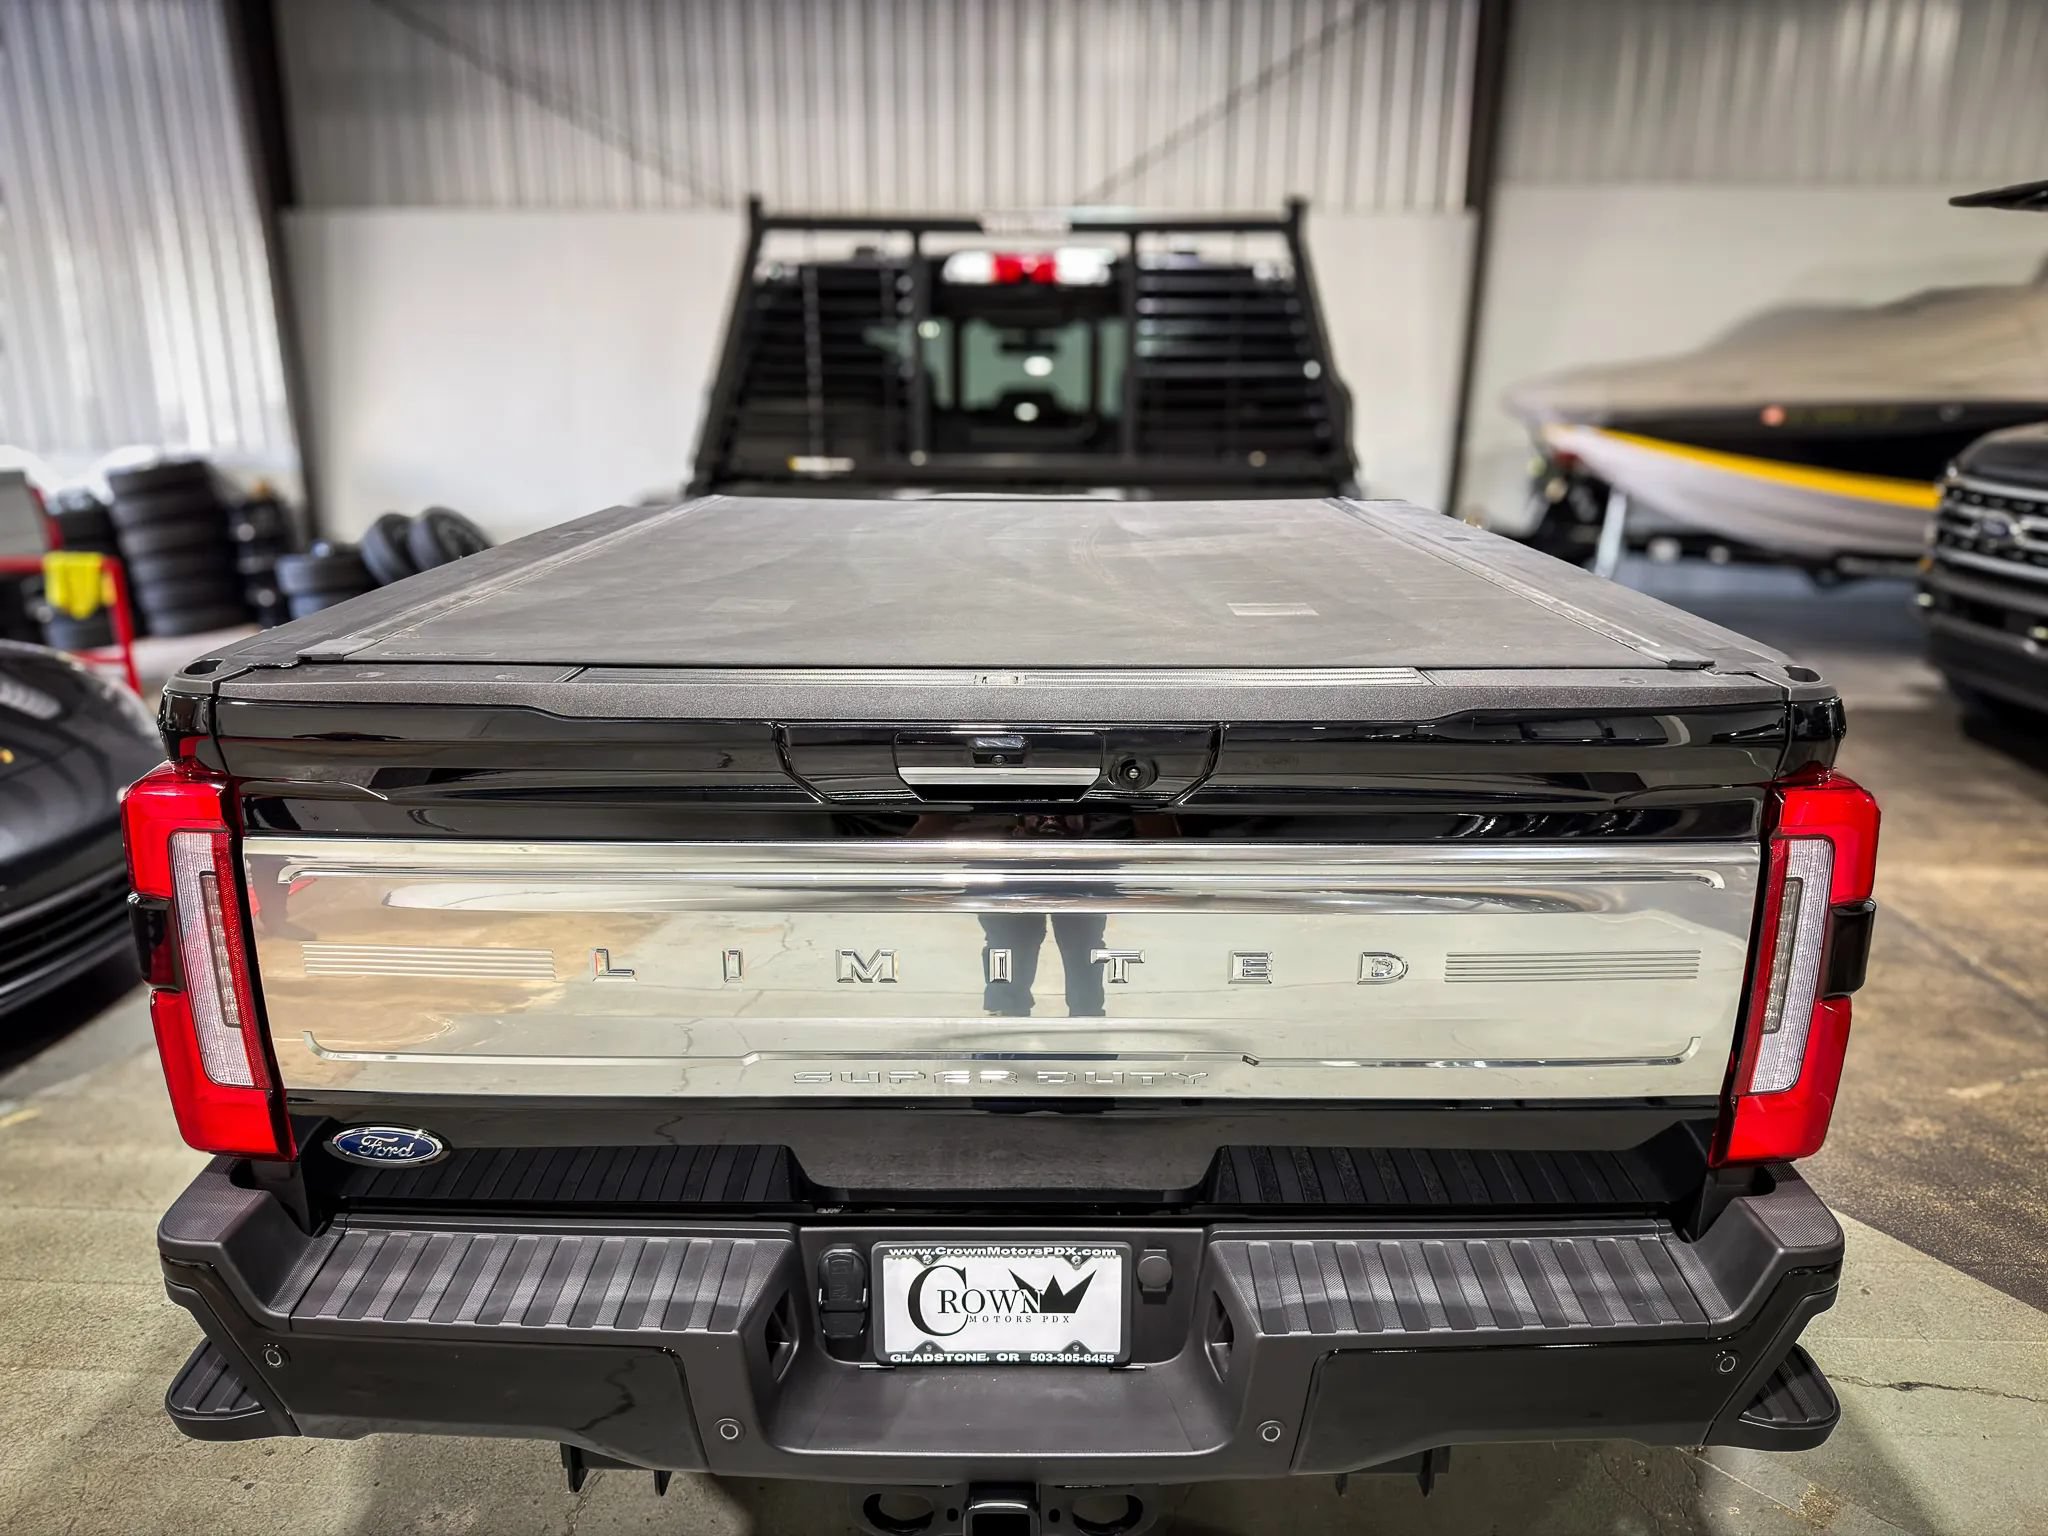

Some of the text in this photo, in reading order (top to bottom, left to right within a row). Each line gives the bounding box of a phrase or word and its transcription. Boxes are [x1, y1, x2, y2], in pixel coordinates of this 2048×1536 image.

[592, 948, 1409, 984] LIMITED
[793, 1070, 1208, 1084] SUPER DUTY
[359, 1135, 415, 1157] Ford
[889, 1246, 1117, 1257] www.CrownMotorsPDX.com
[907, 1265, 1043, 1337] CROWN
[969, 1315, 1070, 1323] MOTORS PDX
[890, 1353, 1115, 1363] GLADSTONE, OR 503-305-6455
